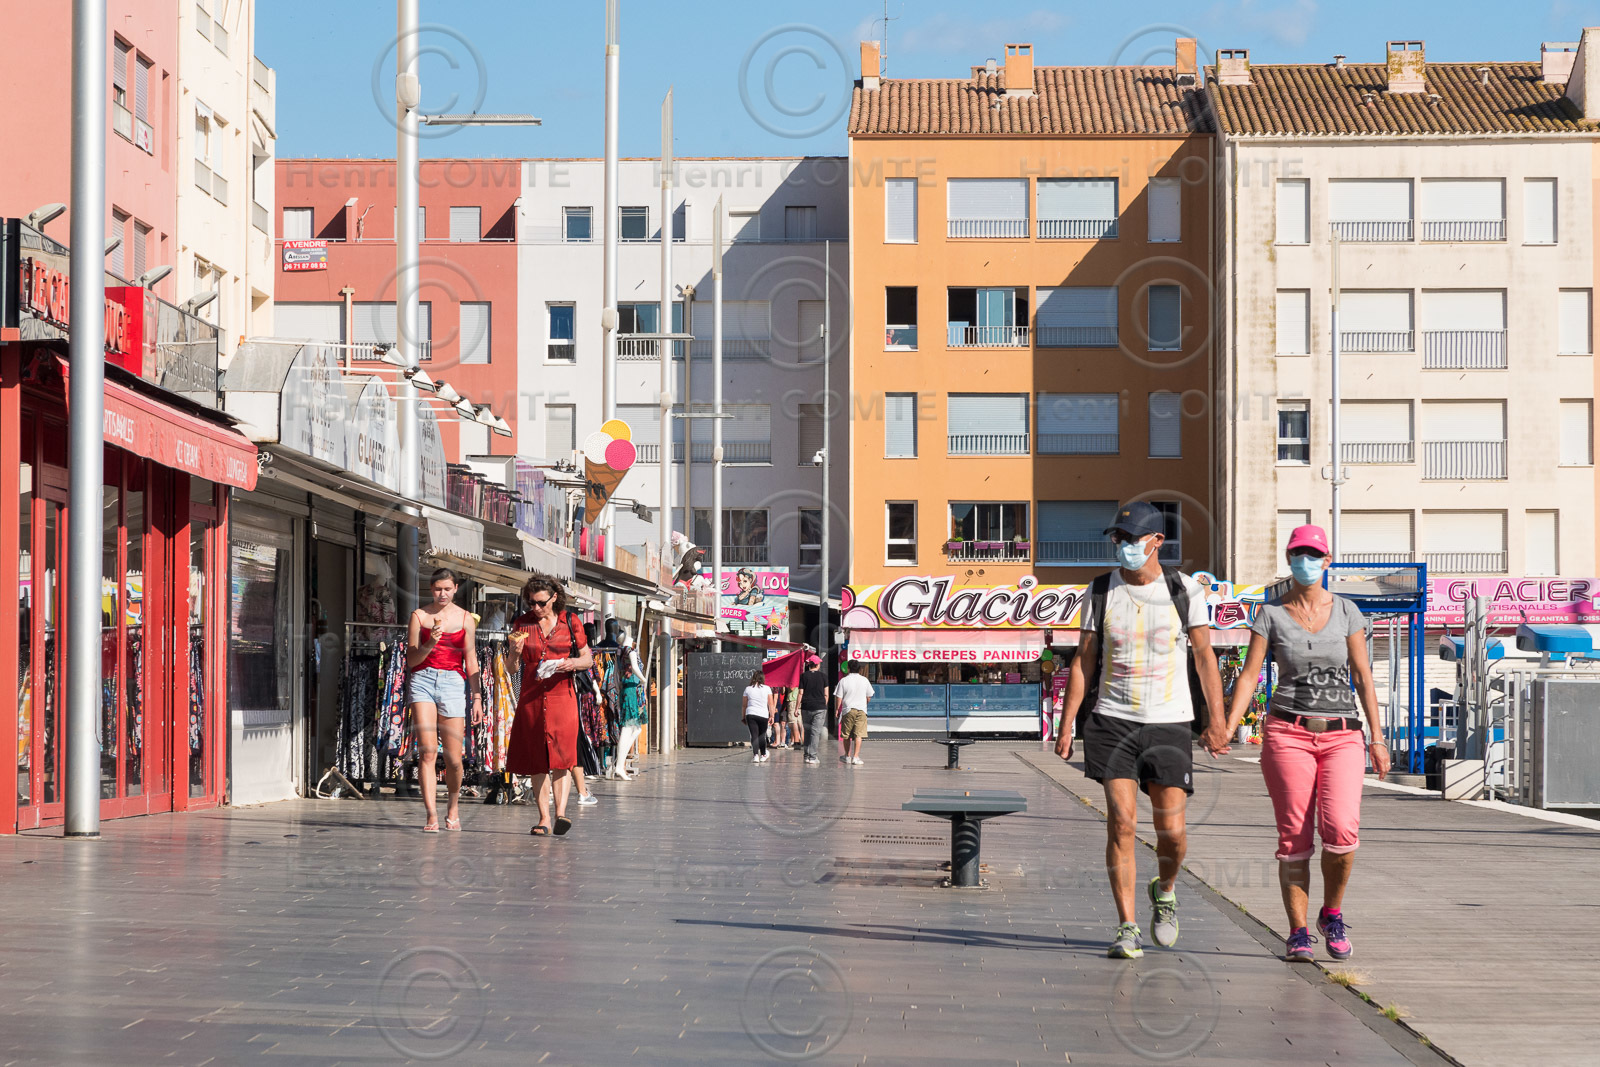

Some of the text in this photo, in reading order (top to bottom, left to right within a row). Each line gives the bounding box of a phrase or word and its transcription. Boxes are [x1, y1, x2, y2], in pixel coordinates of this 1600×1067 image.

[882, 577, 1085, 624] Glacier
[1448, 580, 1591, 603] GLACIER
[852, 649, 1040, 661] GAUFRES CREPES PANINIS
[1308, 688, 1352, 706] you
